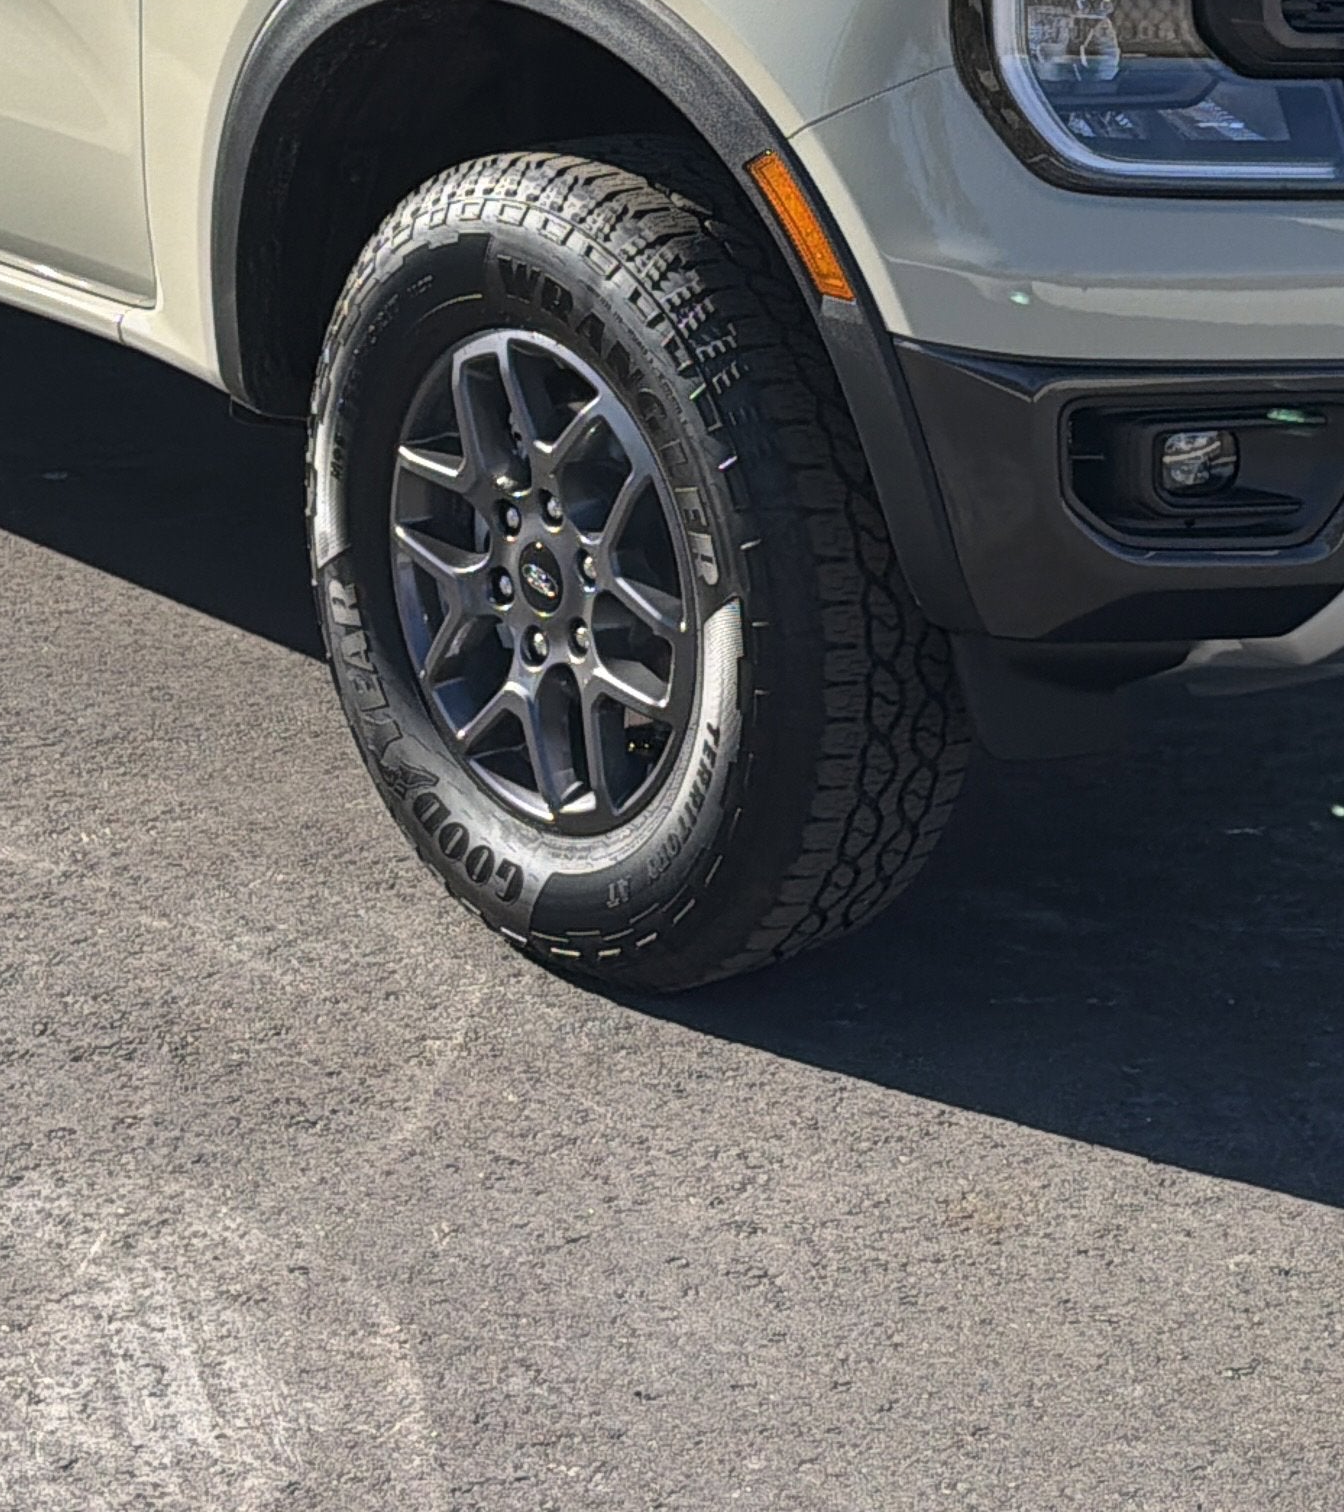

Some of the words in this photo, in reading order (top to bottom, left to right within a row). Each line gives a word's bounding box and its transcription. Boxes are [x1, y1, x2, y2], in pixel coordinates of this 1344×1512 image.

[497, 253, 720, 586] WRANGLER
[328, 579, 524, 906] GOODYEAR
[647, 721, 721, 886] TERRITORY
[606, 874, 633, 908] AT
